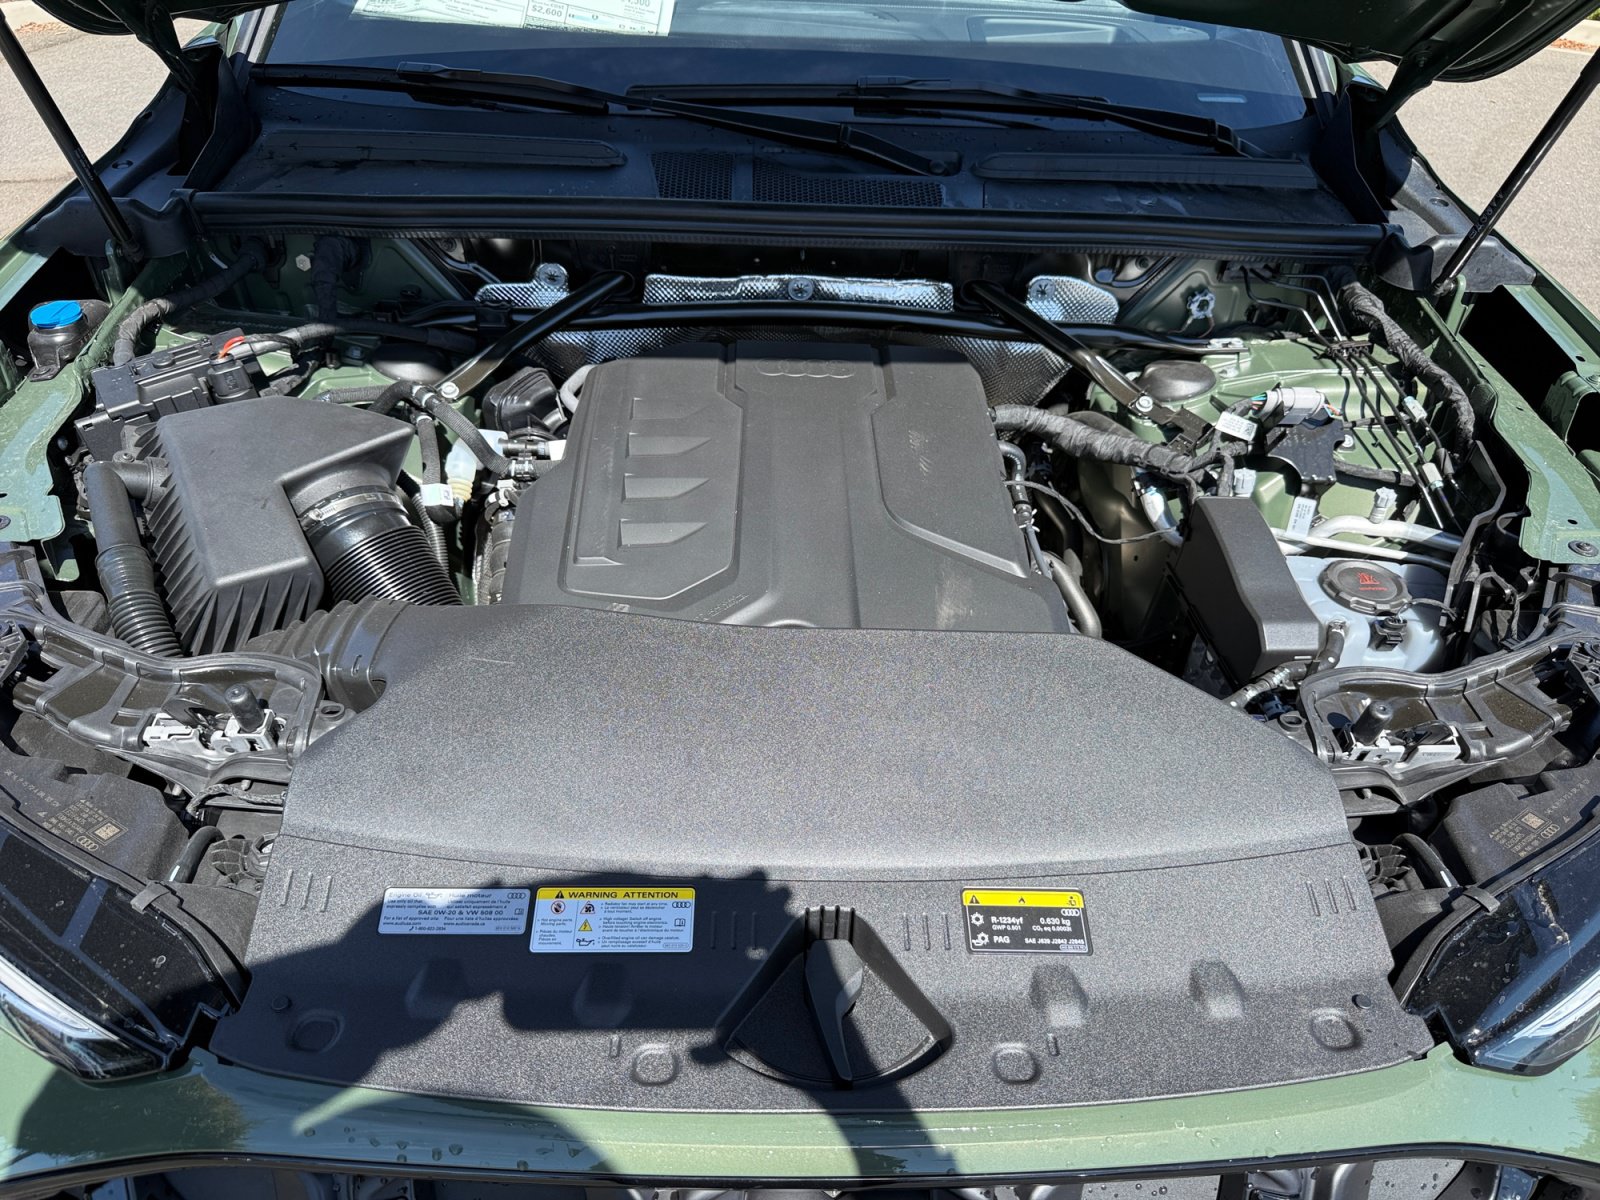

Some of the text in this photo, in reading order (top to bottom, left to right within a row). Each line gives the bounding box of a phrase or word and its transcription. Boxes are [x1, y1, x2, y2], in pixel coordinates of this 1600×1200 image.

[531, 4, 562, 17] $2,600
[991, 917, 1023, 925] R-1234yf
[1061, 918, 1071, 926] kg
